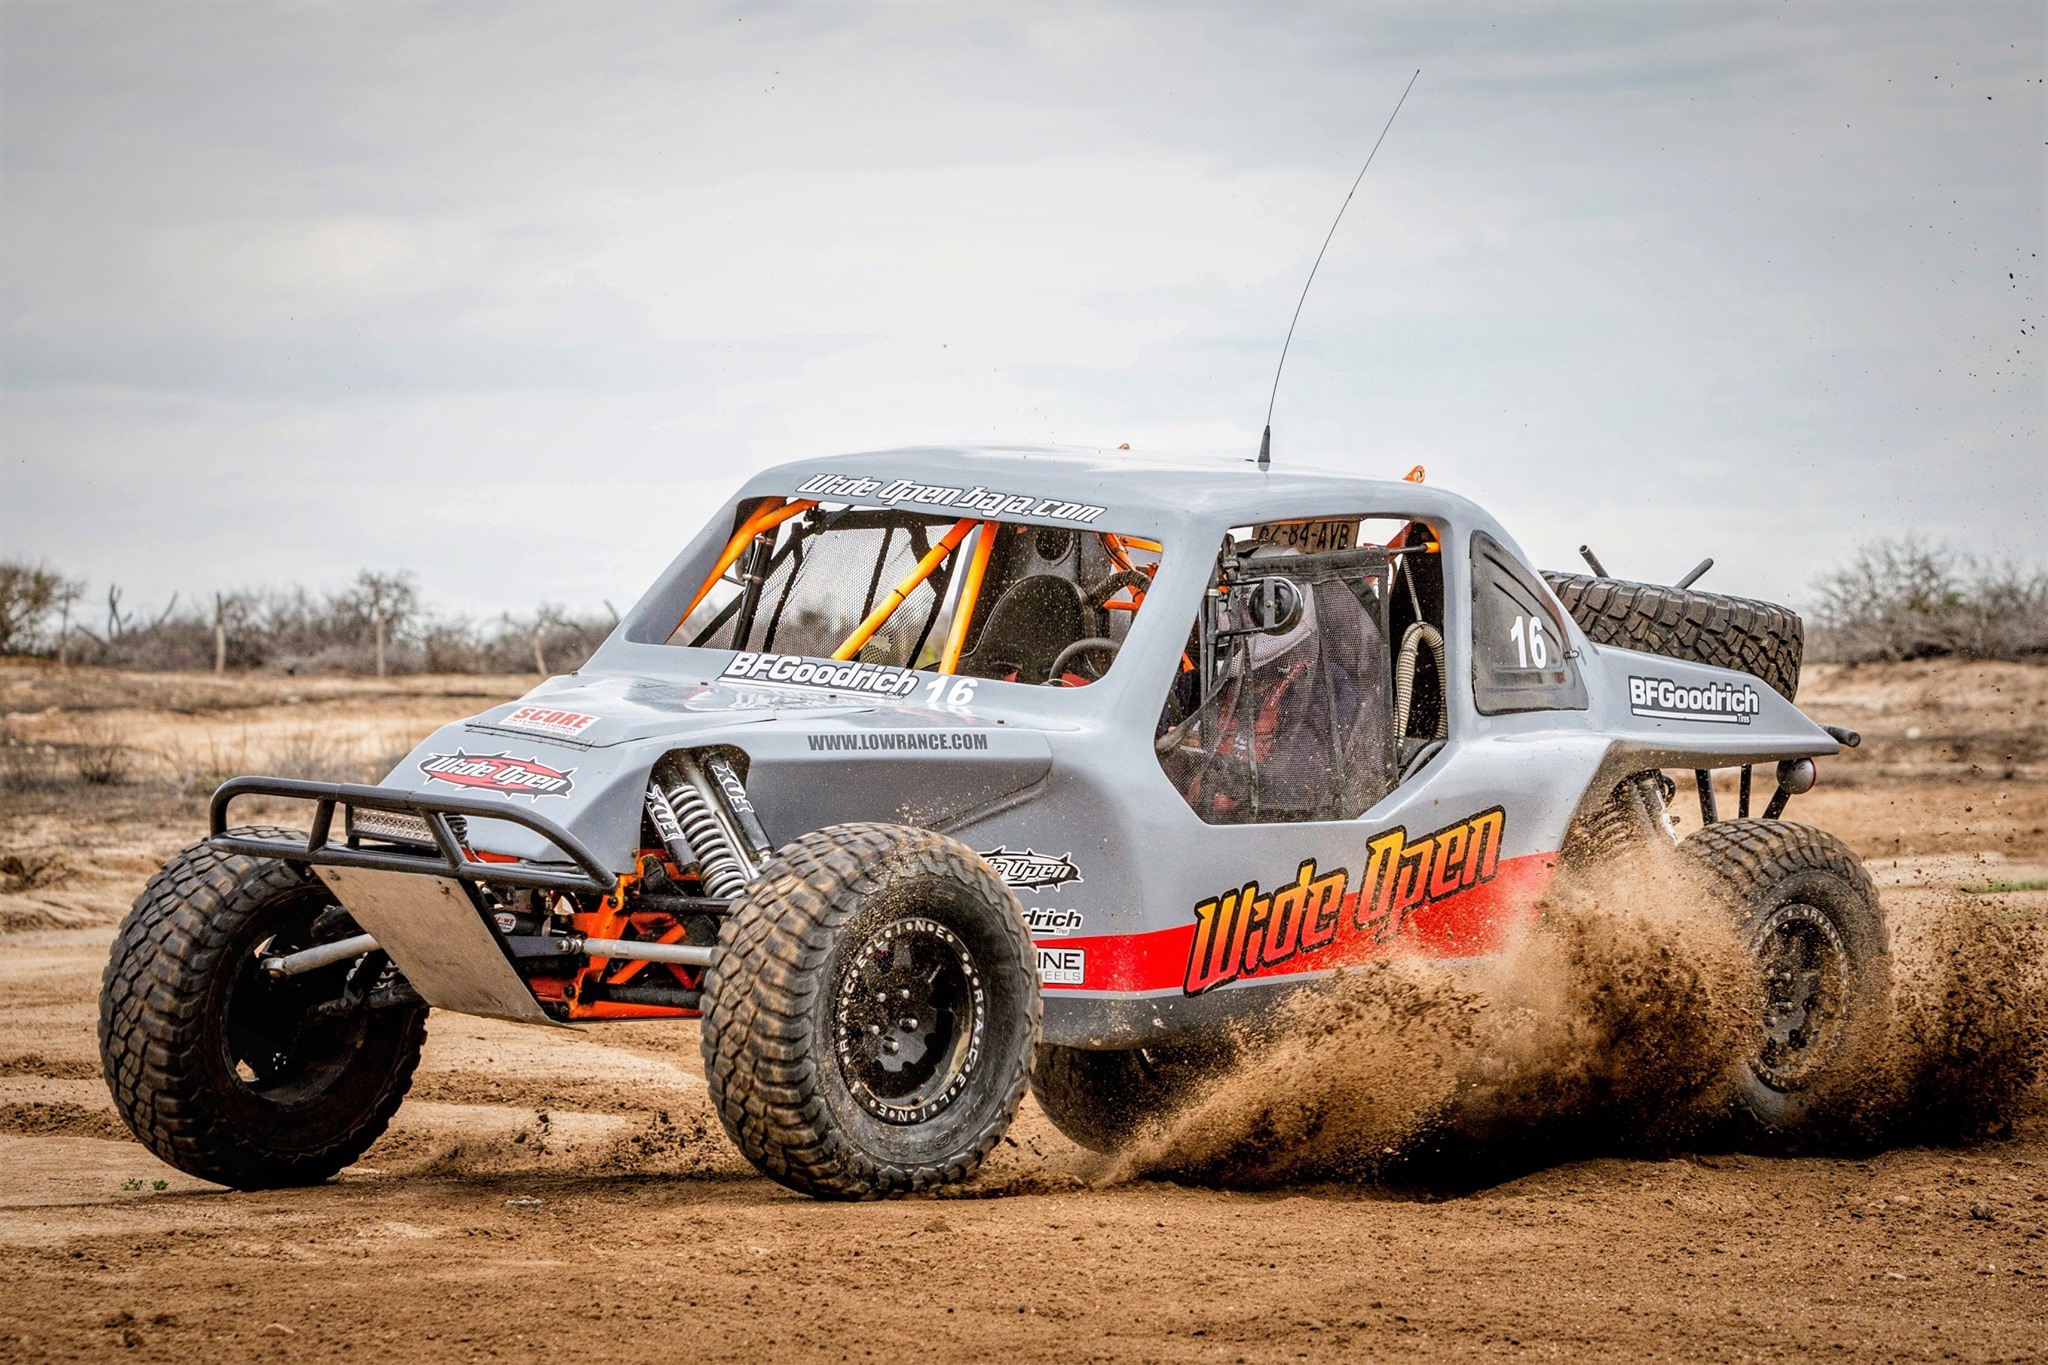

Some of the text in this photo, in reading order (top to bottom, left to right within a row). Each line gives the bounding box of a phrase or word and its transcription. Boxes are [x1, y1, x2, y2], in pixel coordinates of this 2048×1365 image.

[797, 473, 883, 498] Wide
[877, 478, 963, 506] Open
[1510, 615, 1548, 669] 16
[724, 652, 979, 706] BFGoodrich 16
[1630, 677, 1759, 714] BFGoodrich
[513, 707, 595, 729] SCORE
[807, 733, 988, 751] WWW.LOWRANCE.COM
[425, 755, 568, 792] Wide Open
[711, 761, 755, 813] FOX
[1009, 860, 1072, 881] Open
[1183, 804, 1507, 998] Wide Open
[1022, 910, 1082, 928] drich
[1044, 970, 1081, 981] EELS
